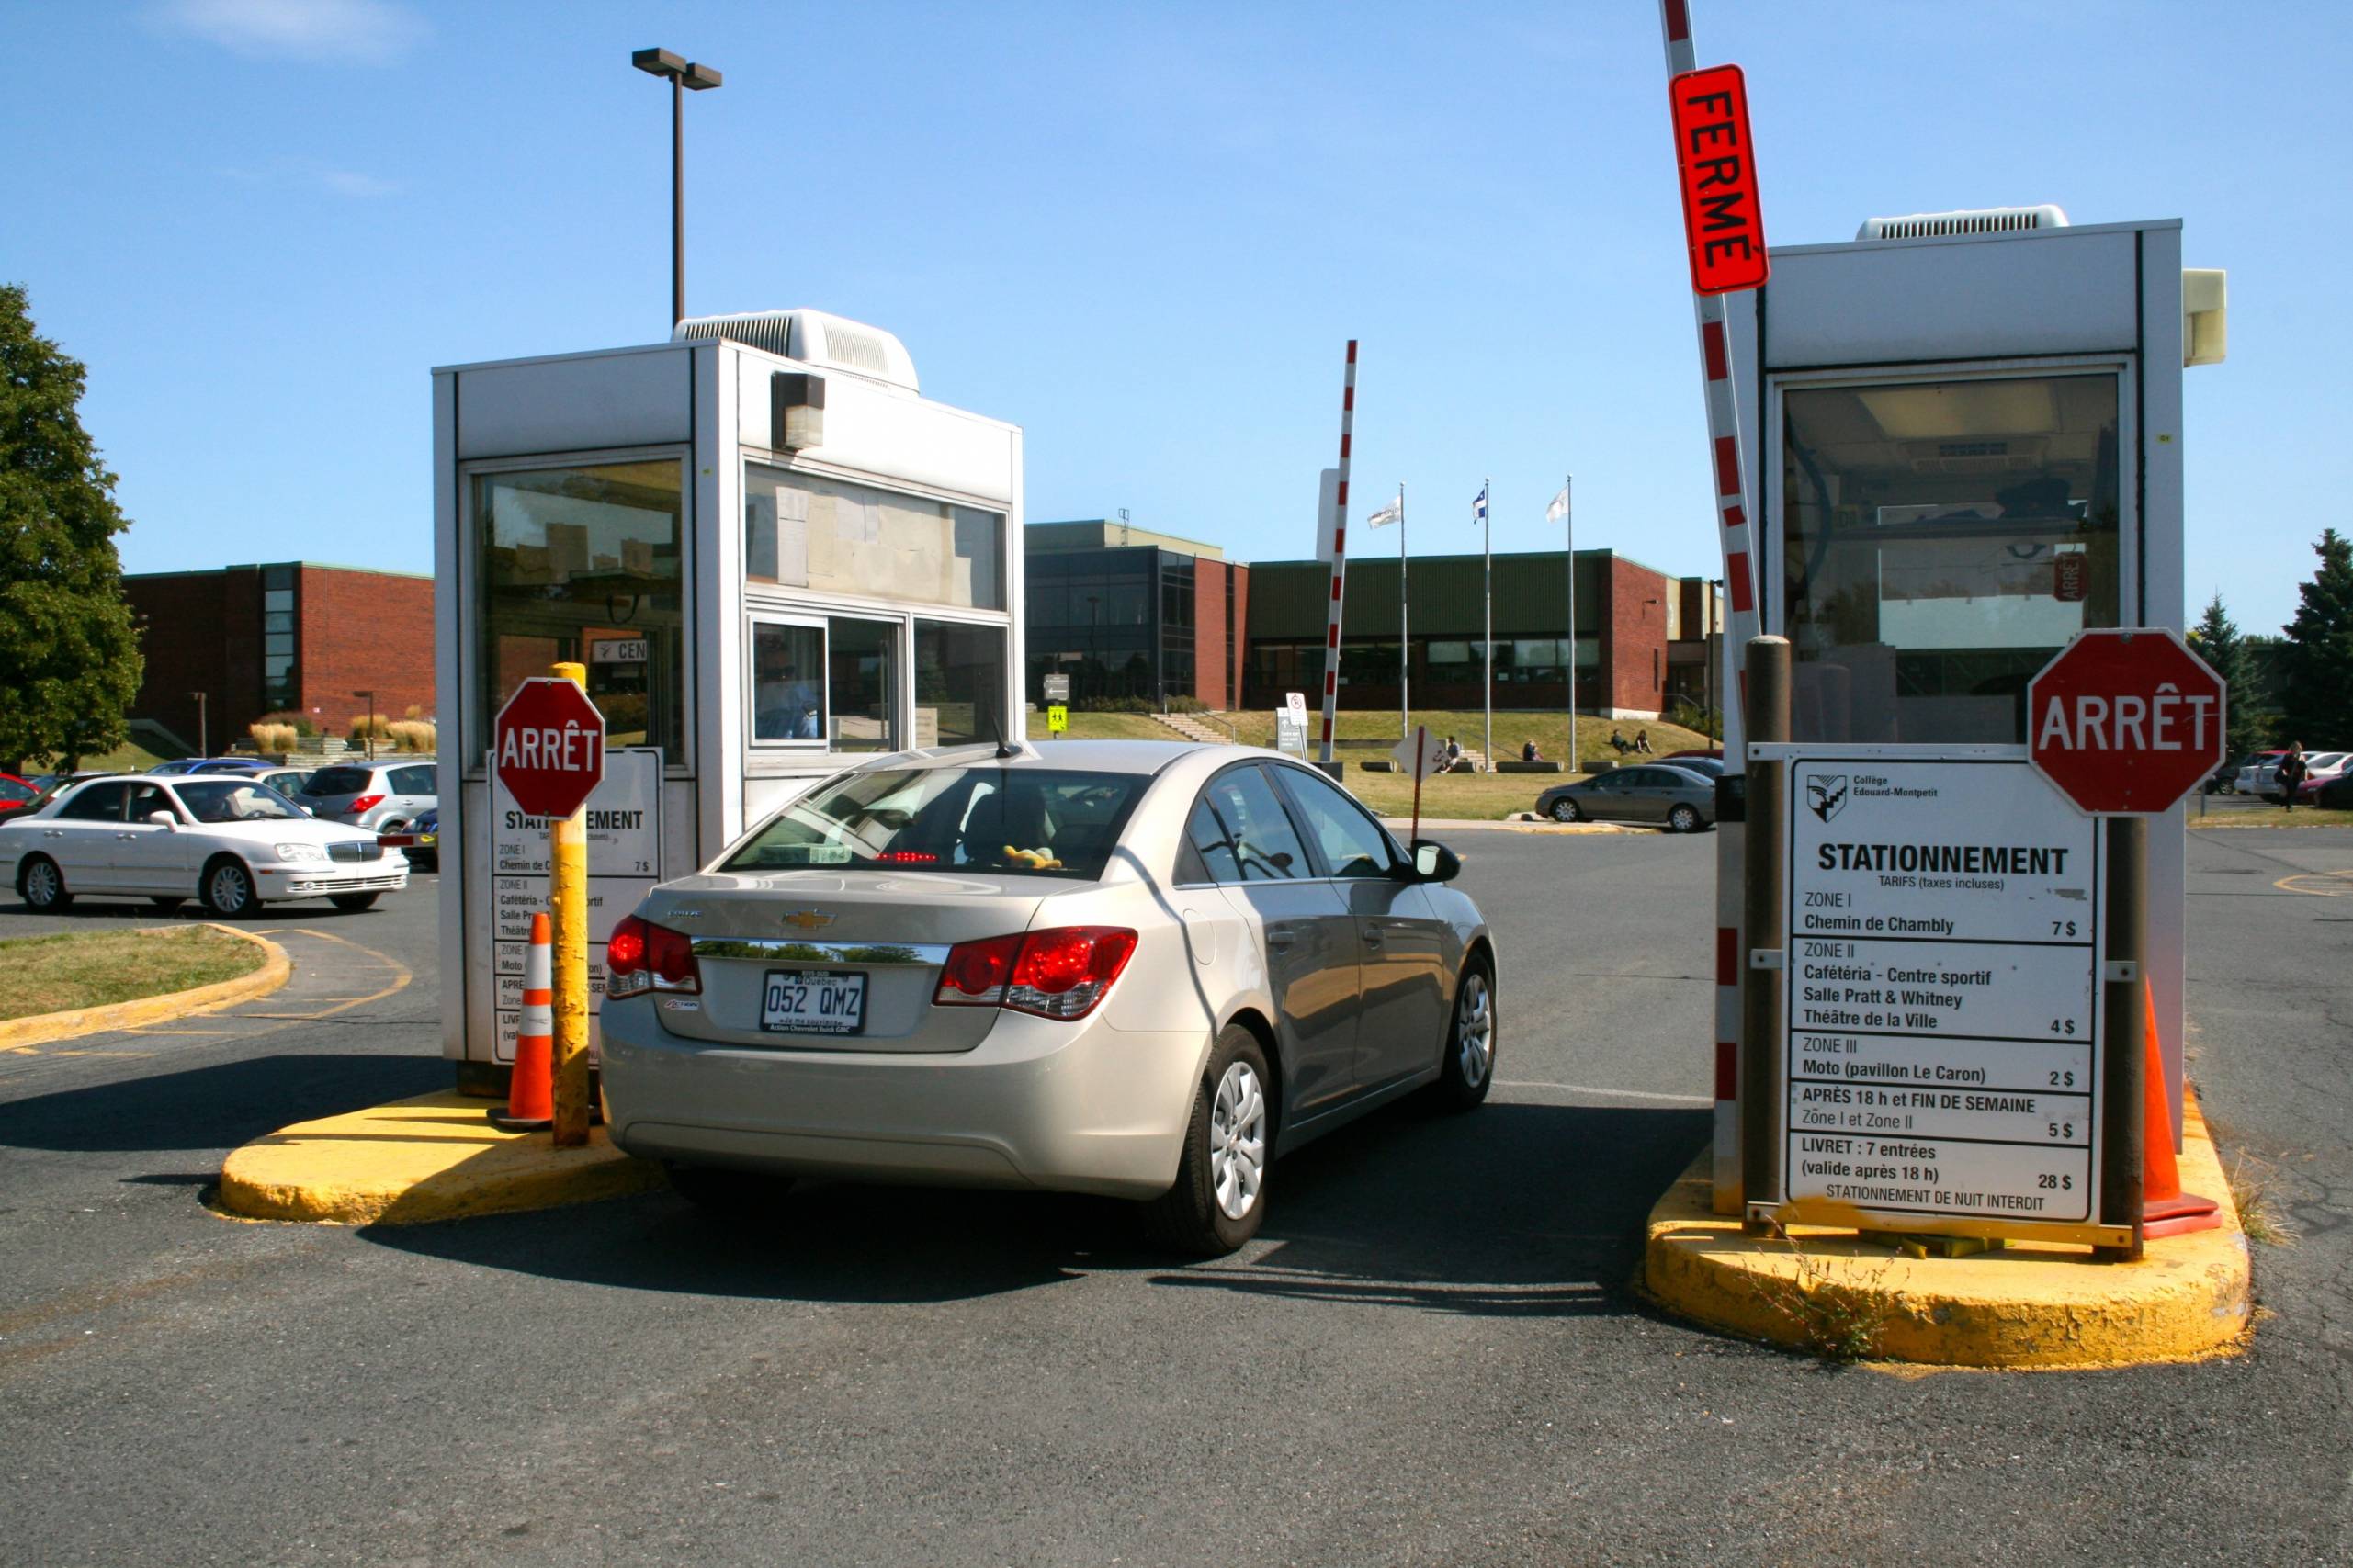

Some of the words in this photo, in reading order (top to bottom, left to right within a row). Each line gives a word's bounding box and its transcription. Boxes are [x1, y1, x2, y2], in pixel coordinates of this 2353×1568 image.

[2038, 682, 2214, 750] ARRÊT
[501, 719, 599, 772] ARRÊT
[1853, 775, 1888, 787] Collège
[506, 810, 642, 829] STAEMENT
[500, 844, 521, 855] ZONE
[1818, 842, 2069, 875] STATIONNEMENT
[500, 860, 530, 871] Chemin
[533, 862, 543, 871] de
[635, 861, 641, 872] 7
[500, 879, 522, 890] ZONE
[1879, 875, 1916, 888] TARIFS
[1919, 877, 1951, 890] (taxes
[1955, 877, 2005, 891] incluses)
[1805, 892, 1842, 908] ZONE
[500, 909, 525, 920] Salle
[1804, 914, 1861, 930] Chemin
[1865, 916, 1884, 931] de
[1888, 917, 1954, 935] Chambly
[2052, 920, 2062, 936] 7
[2065, 920, 2076, 938] $
[1804, 942, 1843, 958] ZONE
[1846, 943, 1854, 958] II
[502, 961, 522, 971] Moto
[1804, 964, 1872, 982] Cafétéria
[1887, 967, 1937, 984] Centre
[1941, 970, 1993, 987] sportif
[502, 978, 525, 990] APRÈ
[767, 985, 809, 1014] 052
[820, 987, 860, 1017] QMZ
[1804, 987, 1841, 1003] Salle
[1843, 987, 1882, 1005] Pratt
[1885, 989, 1897, 1005] &
[1901, 990, 1962, 1009] Whitney
[1804, 1008, 1861, 1027] Théâtre
[1864, 1011, 1884, 1027] de
[1886, 1012, 1901, 1028] la
[1906, 1013, 1938, 1029] Ville
[2051, 1019, 2061, 1033] 4
[2064, 1019, 2076, 1035] $
[1803, 1037, 1842, 1054] ZONE
[1845, 1039, 1857, 1054] III
[1803, 1059, 1840, 1075] Moto
[1844, 1061, 1908, 1080] (pavillon
[1912, 1065, 1932, 1079] Le
[1935, 1066, 1985, 1083] Caron)
[2050, 1072, 2060, 1086] 2
[2063, 1071, 2074, 1088] $
[1803, 1084, 1851, 1104] APRÈS
[1855, 1089, 1876, 1105] 18
[1878, 1090, 1888, 1106] h
[1892, 1092, 1907, 1107] et
[1911, 1093, 1938, 1108] FIN
[1940, 1094, 1961, 1110] DE
[1965, 1095, 2036, 1113] SEMAINE
[1848, 1111, 1862, 1127] et
[1866, 1112, 1901, 1129] Zone
[1905, 1114, 1913, 1129] II
[2048, 1122, 2059, 1137] 5
[2062, 1122, 2074, 1139] $
[1802, 1137, 1853, 1155] LIVRET
[1866, 1141, 1875, 1156] 7
[1880, 1142, 1936, 1159] entrées
[1802, 1161, 1850, 1178] (valide
[1854, 1163, 1898, 1183] après
[1901, 1166, 1920, 1182] 18
[1923, 1166, 1939, 1185] h)
[2037, 1174, 2058, 1190] 28
[2061, 1173, 2072, 1190] $
[1826, 1183, 1930, 1203] STATIONNEMENT
[1934, 1190, 1952, 1205] DE
[1955, 1191, 1985, 1207] NUIT
[1987, 1194, 2044, 1212] INTERDIT
